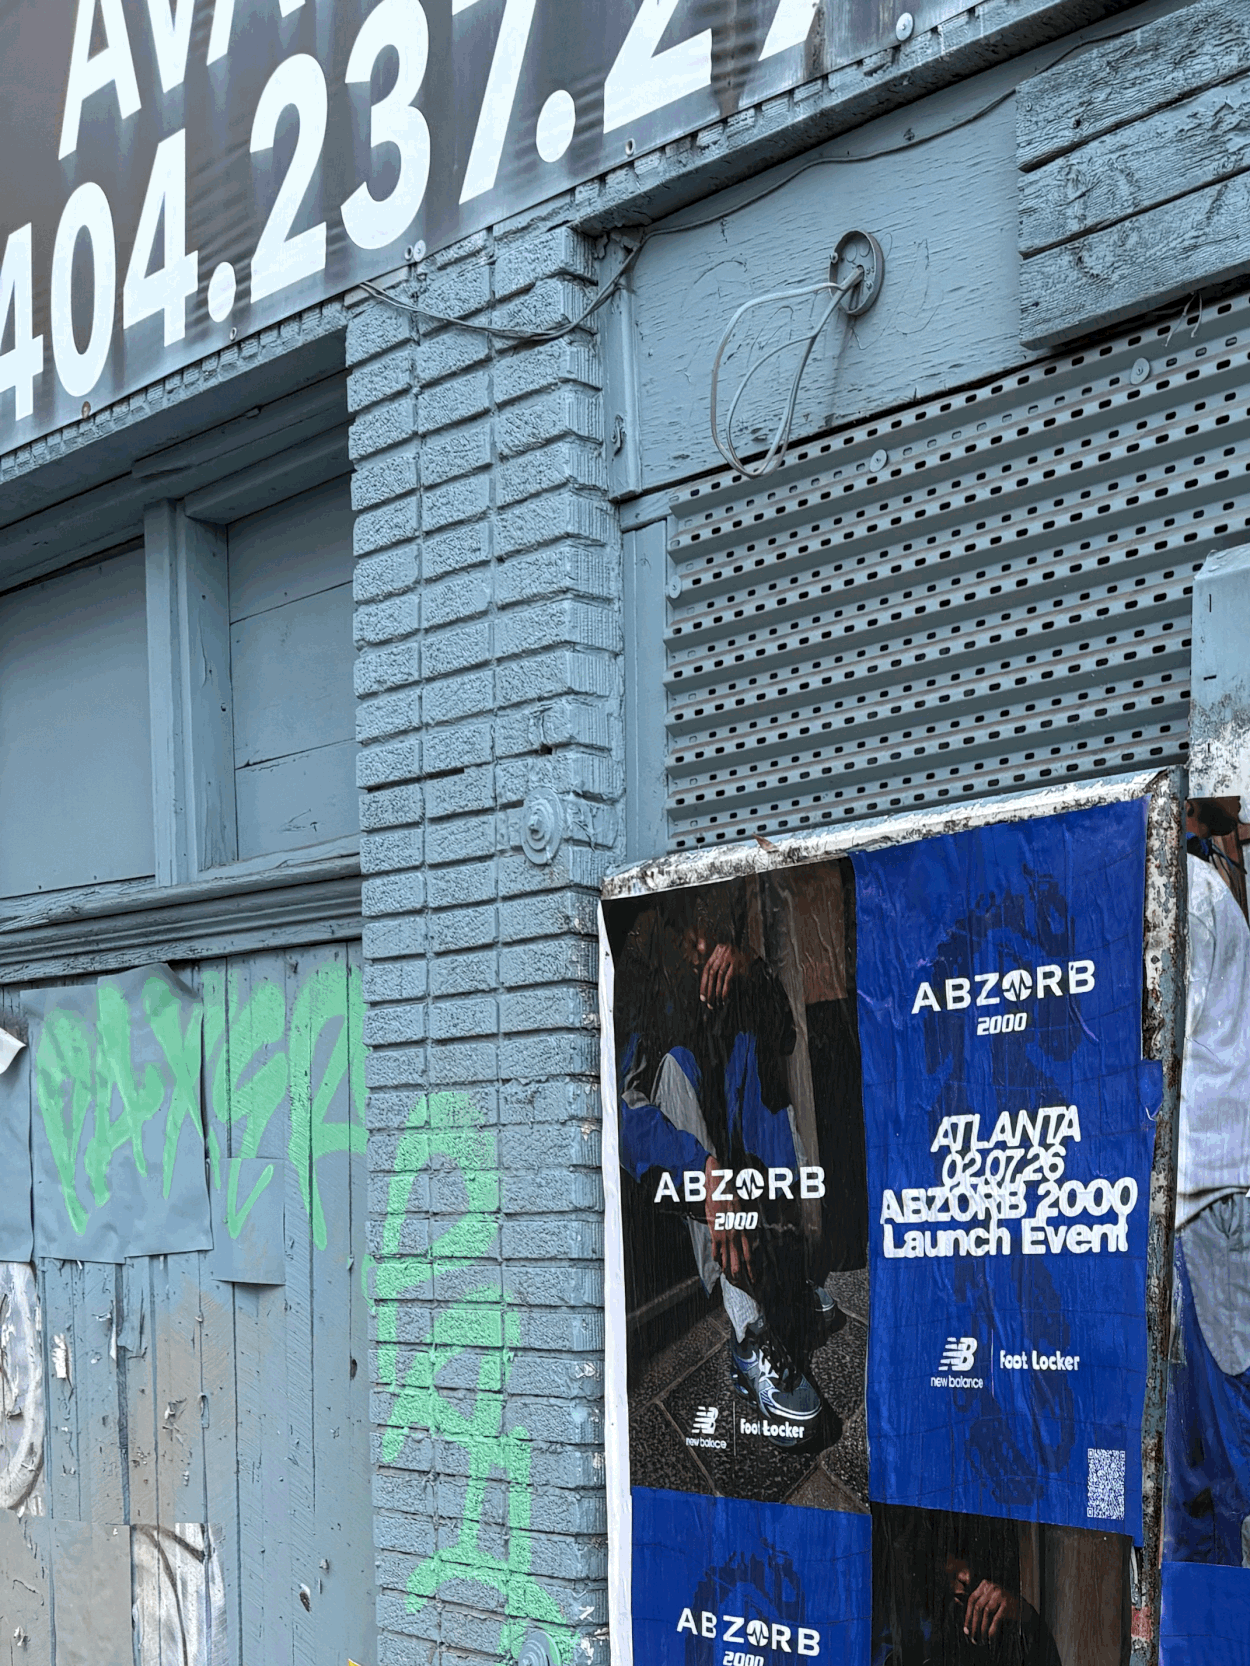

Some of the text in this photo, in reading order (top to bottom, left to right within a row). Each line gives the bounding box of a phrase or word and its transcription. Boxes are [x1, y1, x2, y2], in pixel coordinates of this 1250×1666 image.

[912, 960, 1096, 1014] ABZORB
[977, 1012, 1027, 1035] 2000
[930, 1105, 1081, 1153] ATLANTA
[654, 1166, 826, 1203] ABZORB
[880, 1177, 1138, 1224] ABZORB 2000
[714, 1212, 758, 1231] 2000
[883, 1217, 1128, 1258] Launch Event
[1000, 1349, 1080, 1371] Foot Locker
[931, 1375, 984, 1388] new balance
[686, 1437, 699, 1446] new
[762, 1420, 805, 1438] Locker
[676, 1607, 821, 1657] ABZORB
